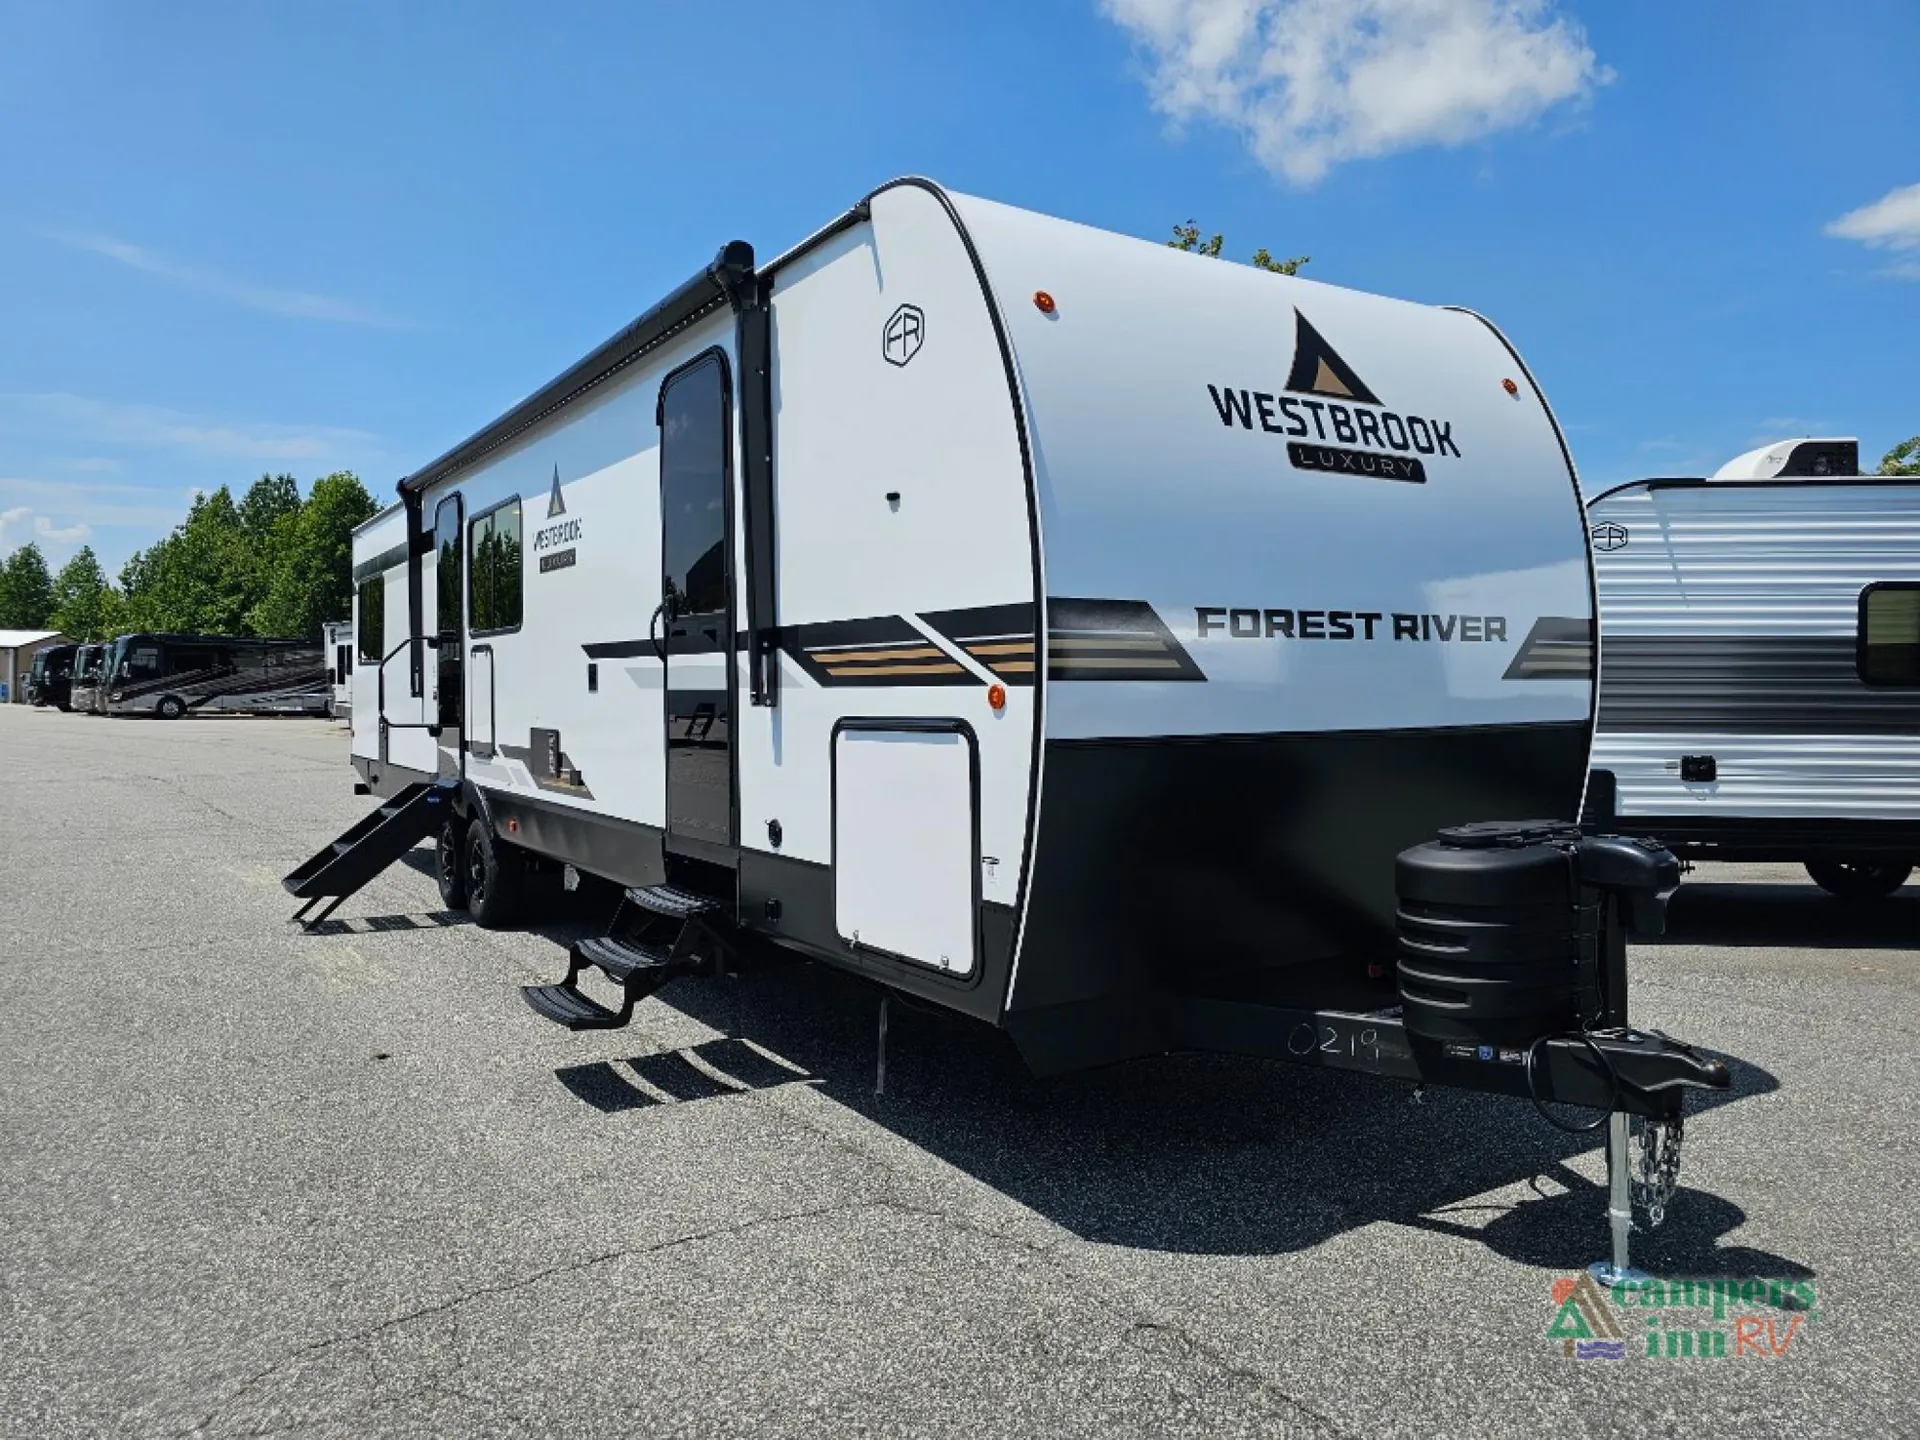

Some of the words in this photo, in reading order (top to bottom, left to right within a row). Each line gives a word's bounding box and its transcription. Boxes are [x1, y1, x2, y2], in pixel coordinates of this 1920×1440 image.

[1207, 383, 1462, 458] WESTBROOK
[1298, 446, 1416, 478] LUXURY
[1194, 606, 1383, 641] FOREST
[1391, 612, 1508, 643] RIVER
